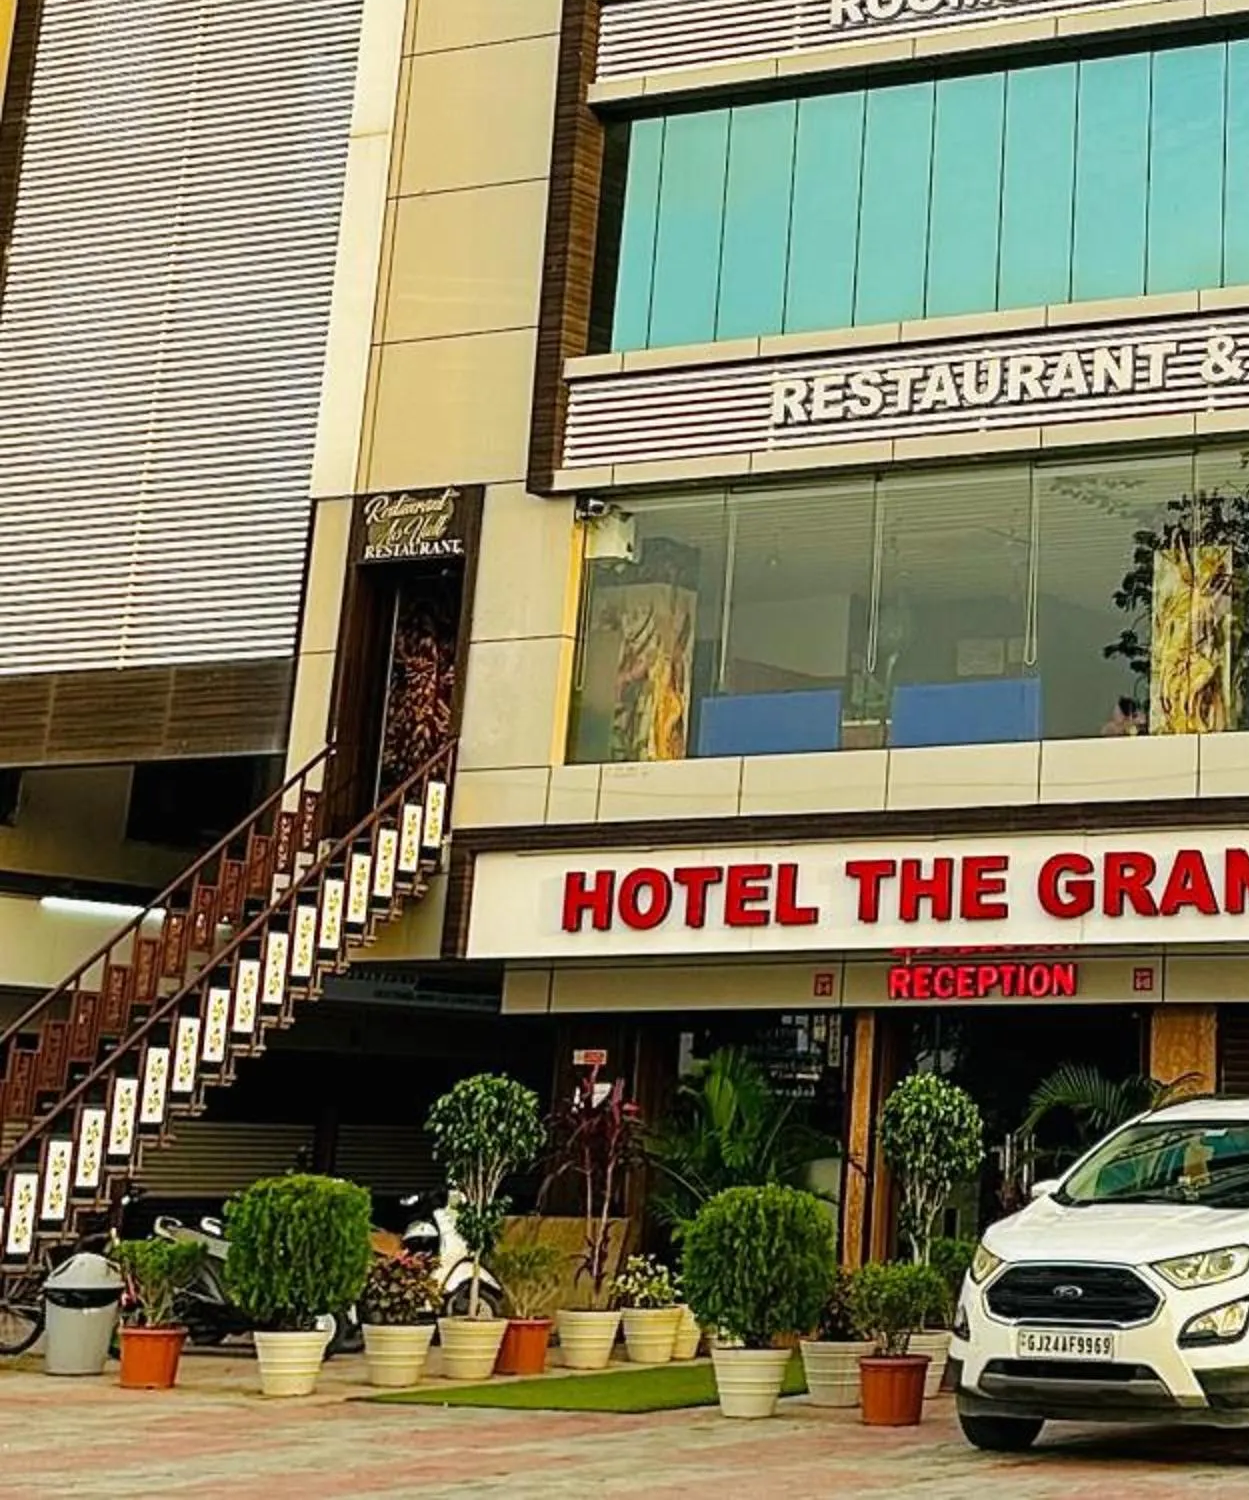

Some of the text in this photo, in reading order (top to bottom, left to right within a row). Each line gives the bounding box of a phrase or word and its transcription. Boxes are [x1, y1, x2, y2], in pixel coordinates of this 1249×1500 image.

[770, 342, 1179, 427] RESTAURANT
[1201, 334, 1245, 383] &
[364, 539, 464, 560] RESTAURANT
[562, 862, 818, 932] HOTEL
[846, 855, 1009, 923] THE
[889, 963, 1078, 999] RECEPTION
